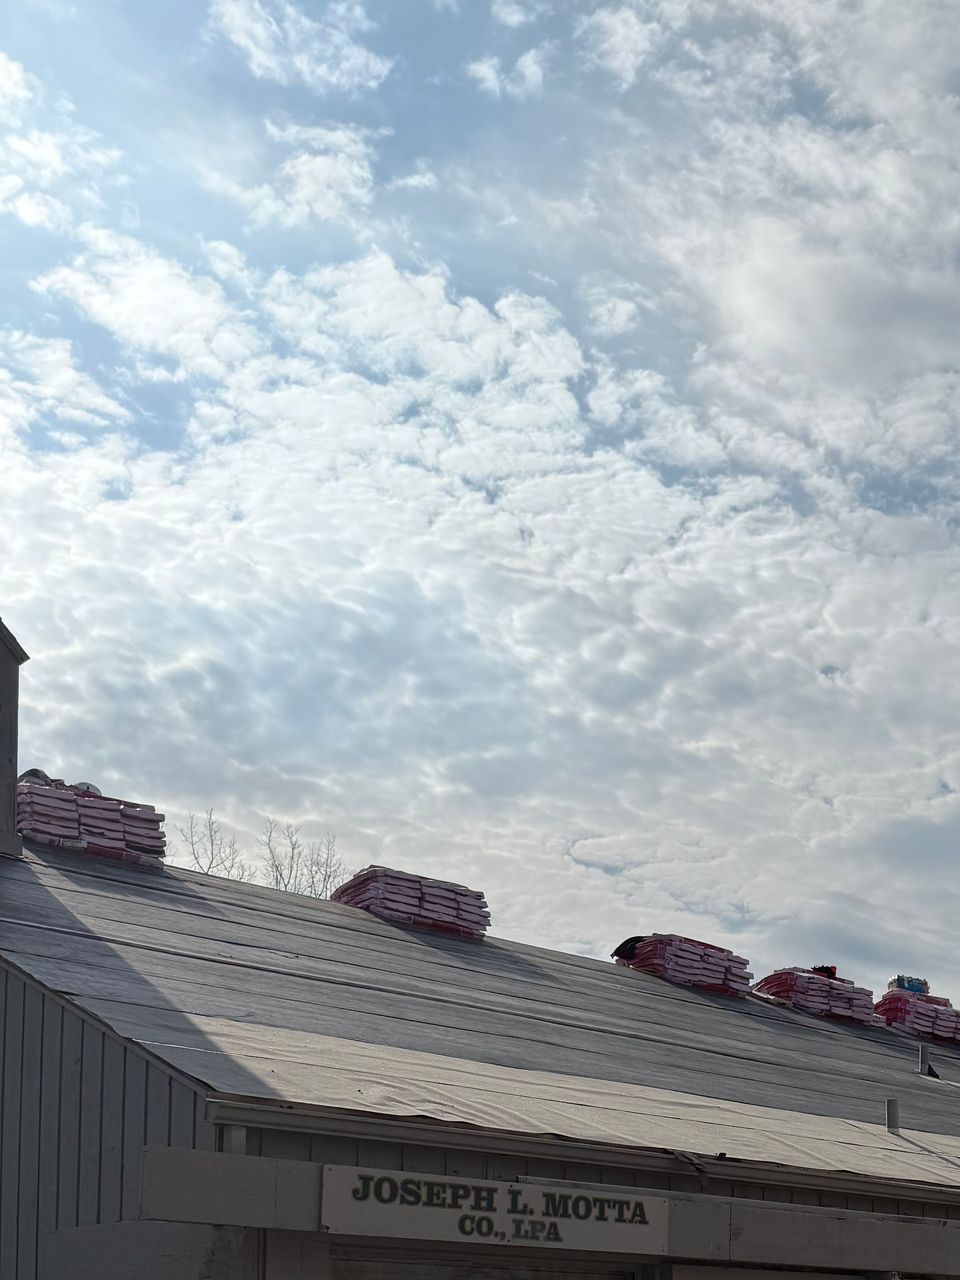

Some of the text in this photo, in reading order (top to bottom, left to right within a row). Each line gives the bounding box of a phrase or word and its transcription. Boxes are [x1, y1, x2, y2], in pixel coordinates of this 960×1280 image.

[352, 1174, 649, 1225] JOSEPH L. MOTTA
[458, 1213, 563, 1242] CO., LPA
